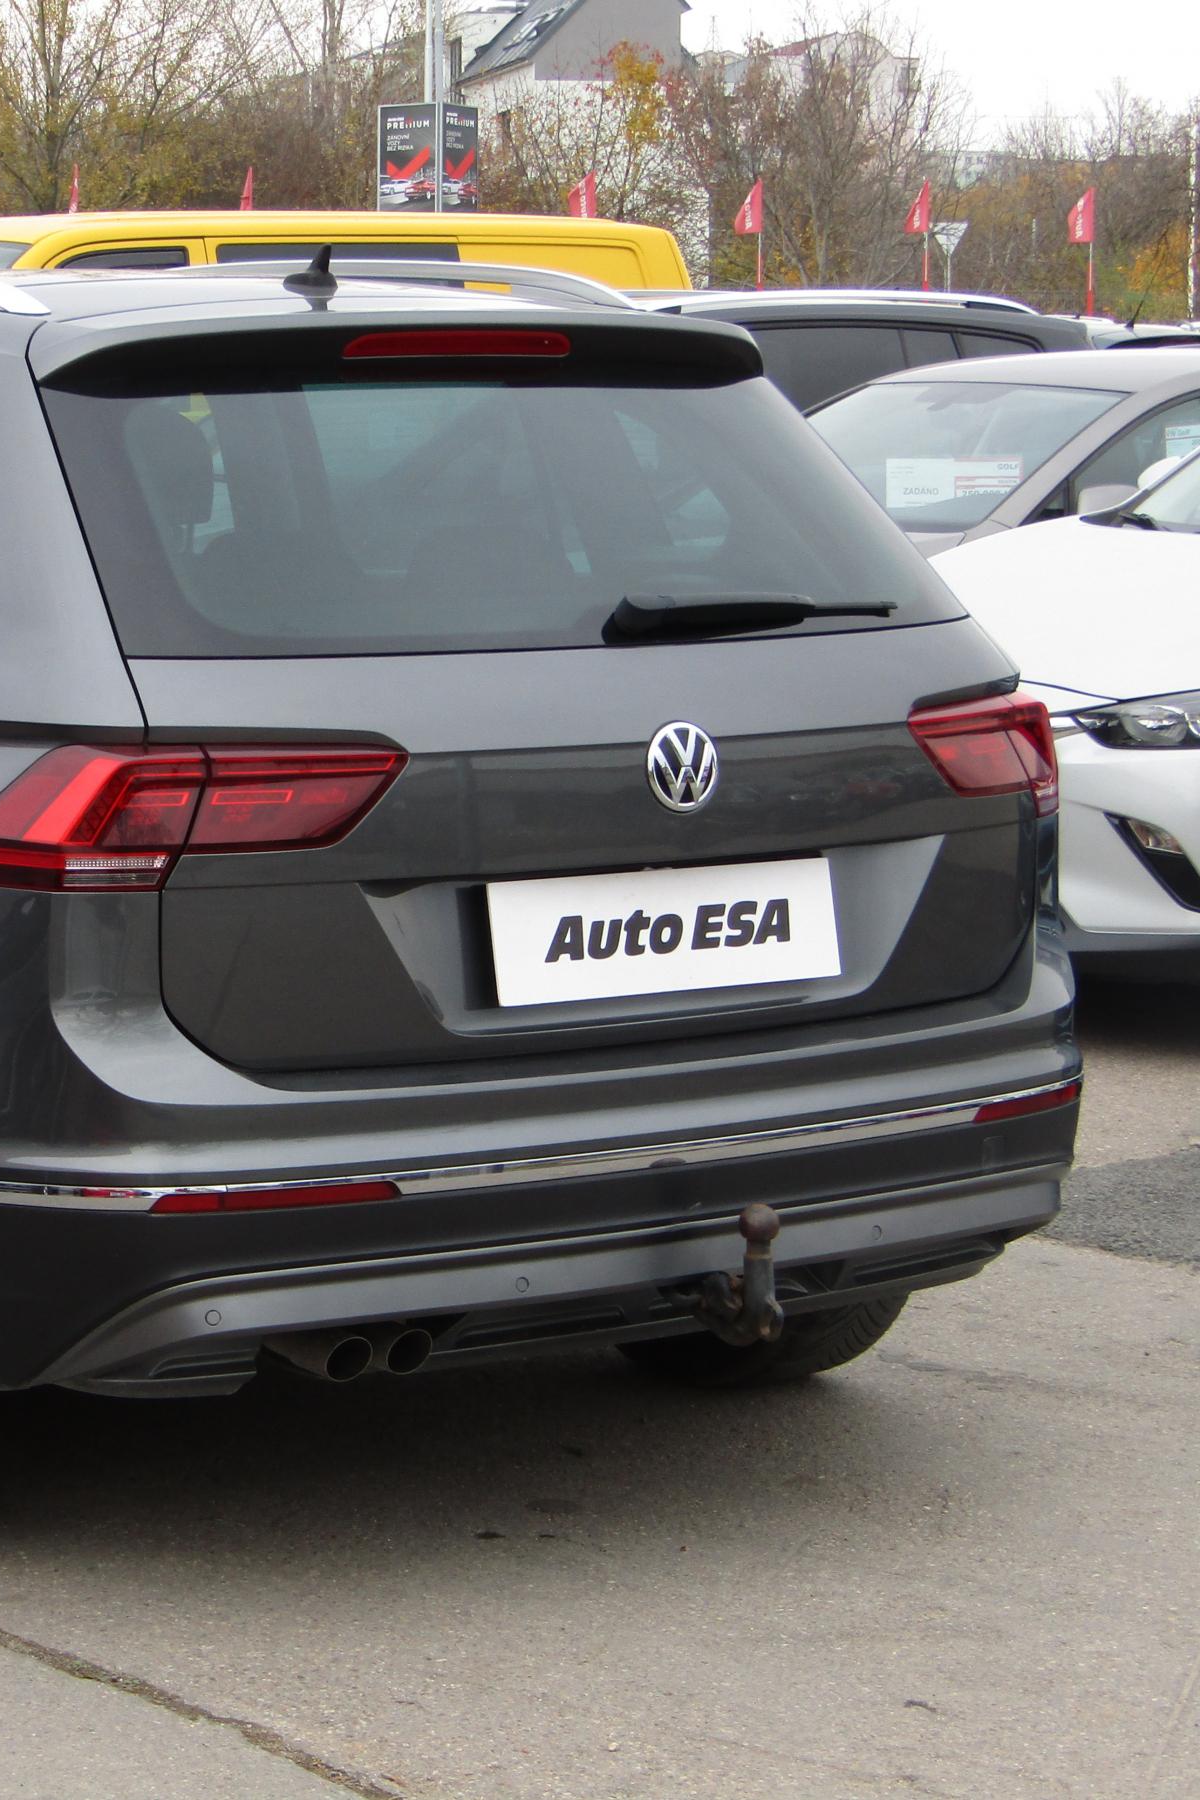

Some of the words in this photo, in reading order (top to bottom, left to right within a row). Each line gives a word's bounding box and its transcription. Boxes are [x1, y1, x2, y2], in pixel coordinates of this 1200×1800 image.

[387, 120, 430, 130] PREMIUM
[544, 909, 684, 963] Auto
[691, 898, 790, 950] ESA
